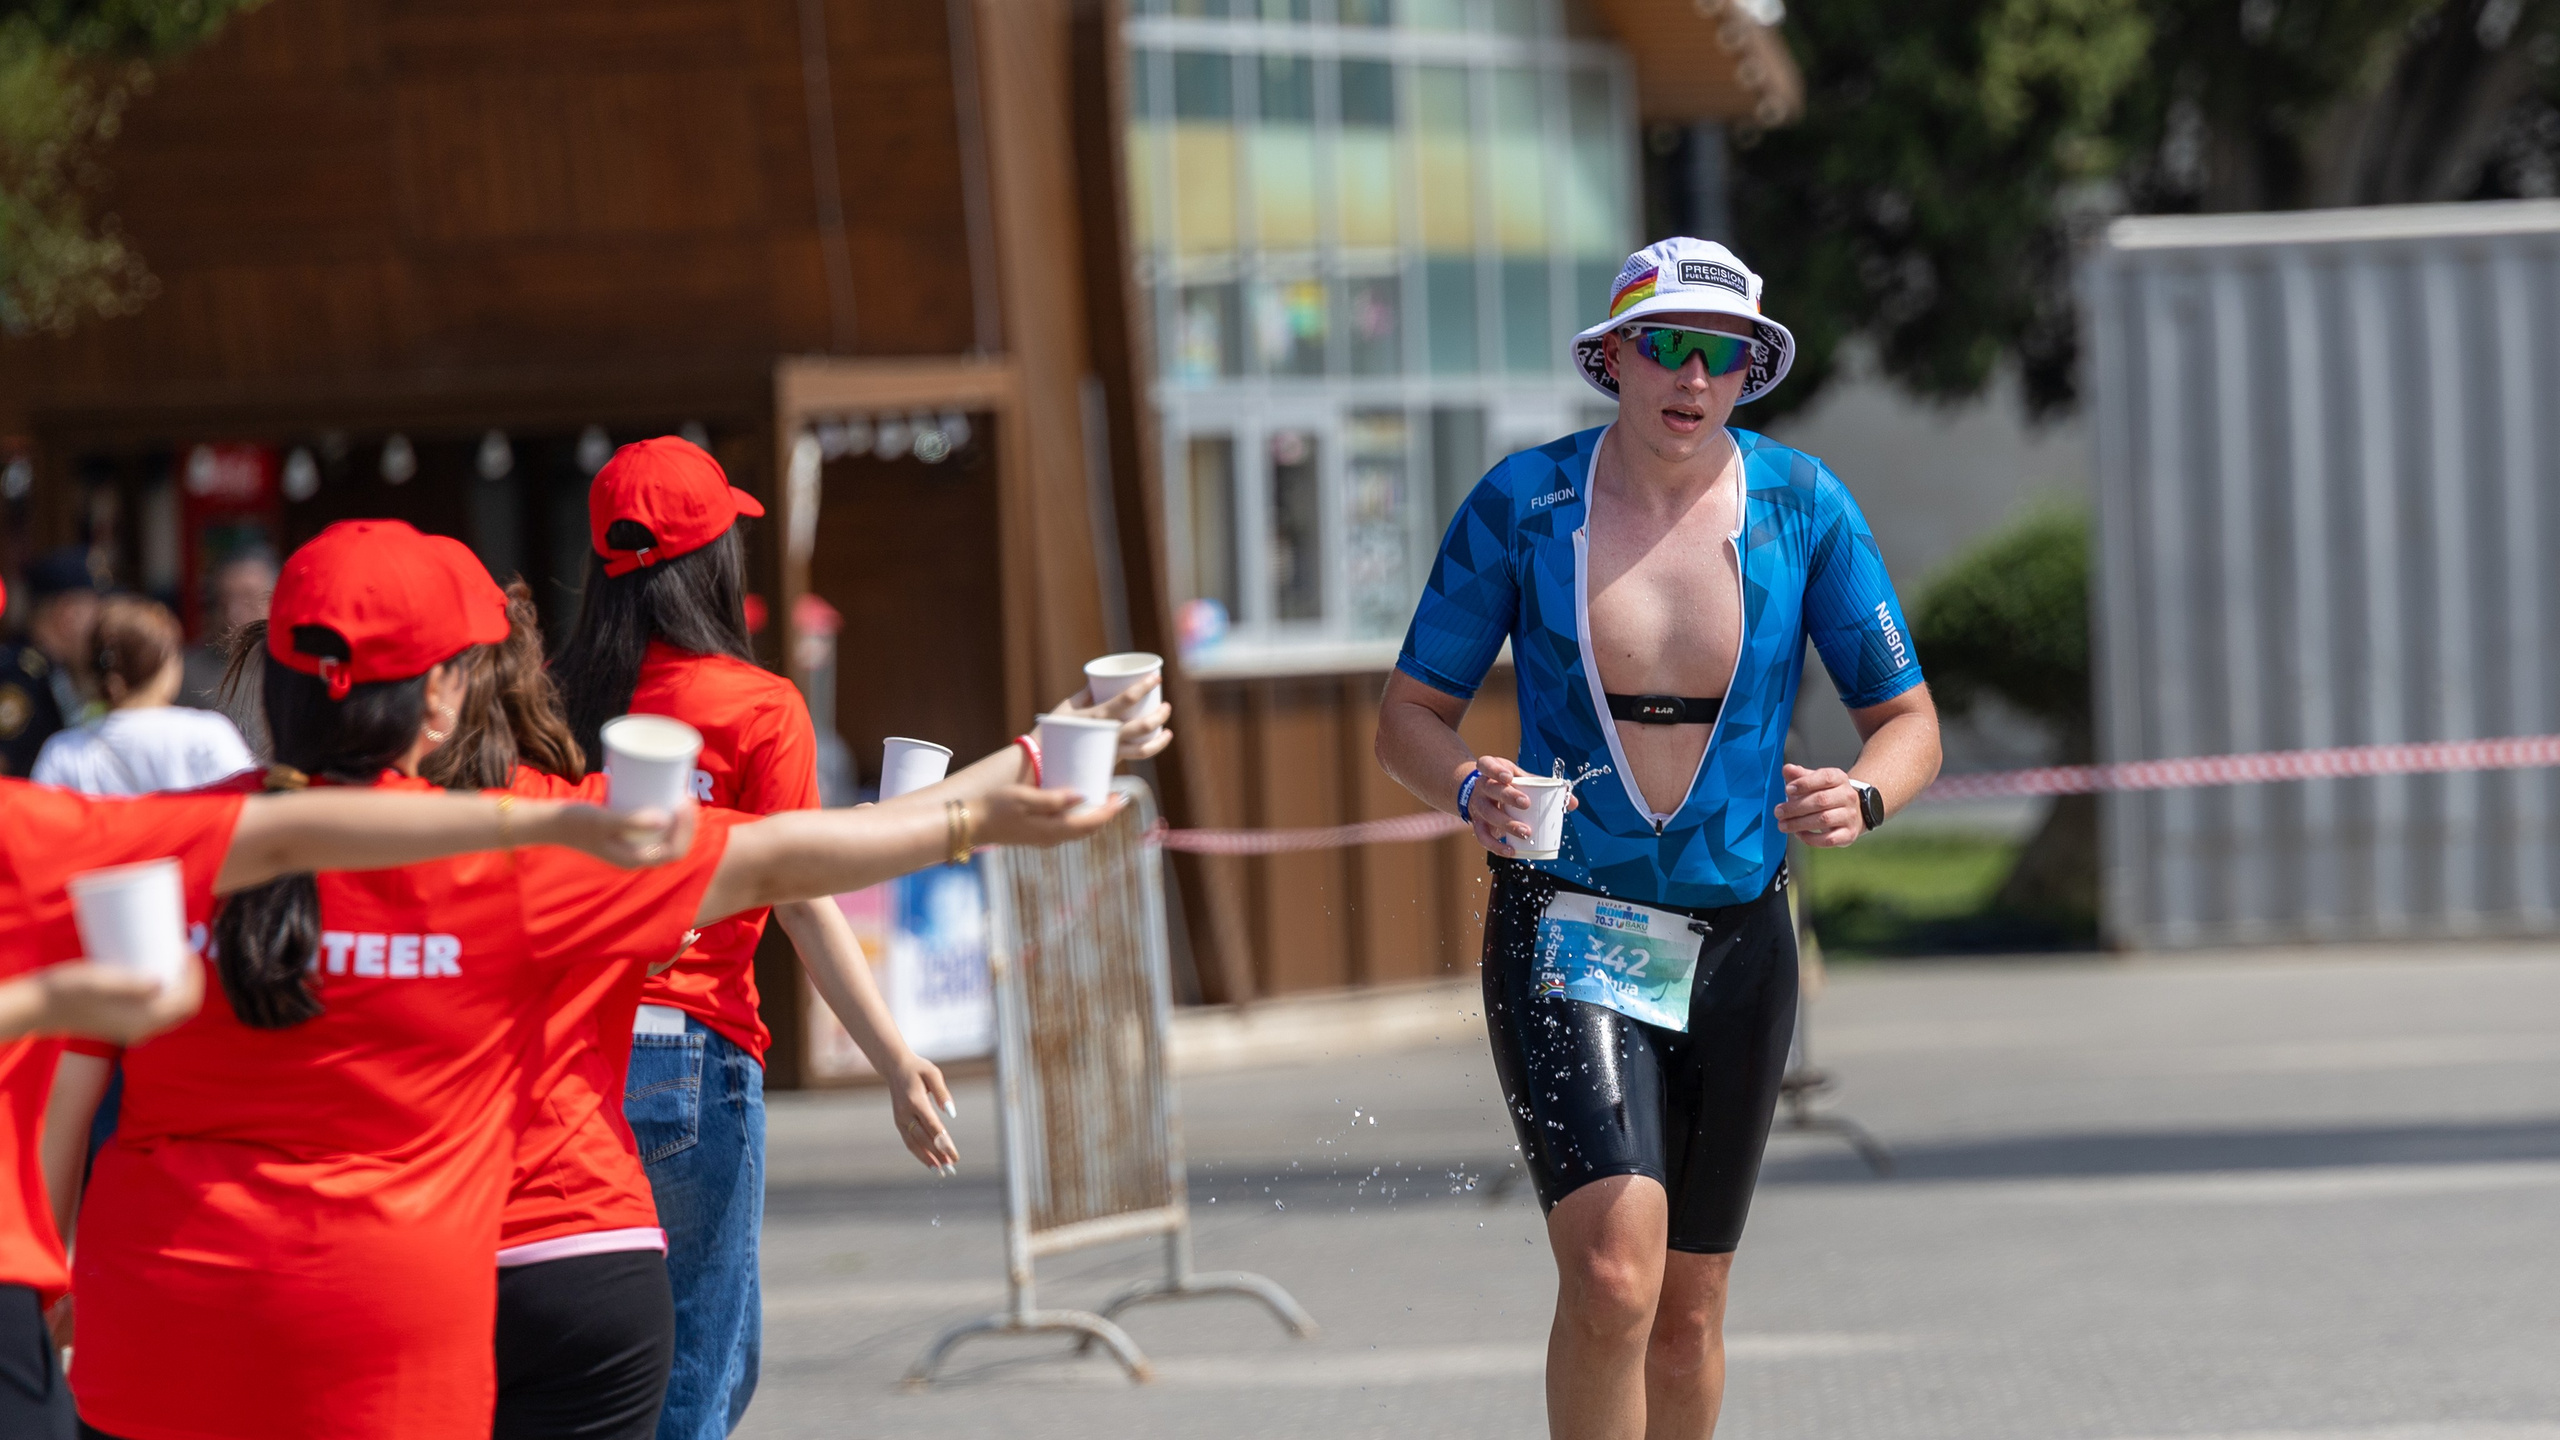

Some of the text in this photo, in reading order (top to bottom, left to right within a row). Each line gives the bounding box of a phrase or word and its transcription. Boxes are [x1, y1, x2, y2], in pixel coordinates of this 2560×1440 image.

[1685, 265, 1744, 286] PRECISION
[1711, 276, 1745, 293] HYDRATION
[1531, 486, 1575, 509] FUSION
[1874, 600, 1911, 669] FUSION
[1643, 706, 1675, 714] POLAR
[1595, 905, 1650, 924] IRONMAN
[1595, 915, 1614, 927] 70.3
[1624, 920, 1649, 931] BAKU
[1543, 924, 1562, 968] M25-29
[1584, 964, 1640, 997] Johua
